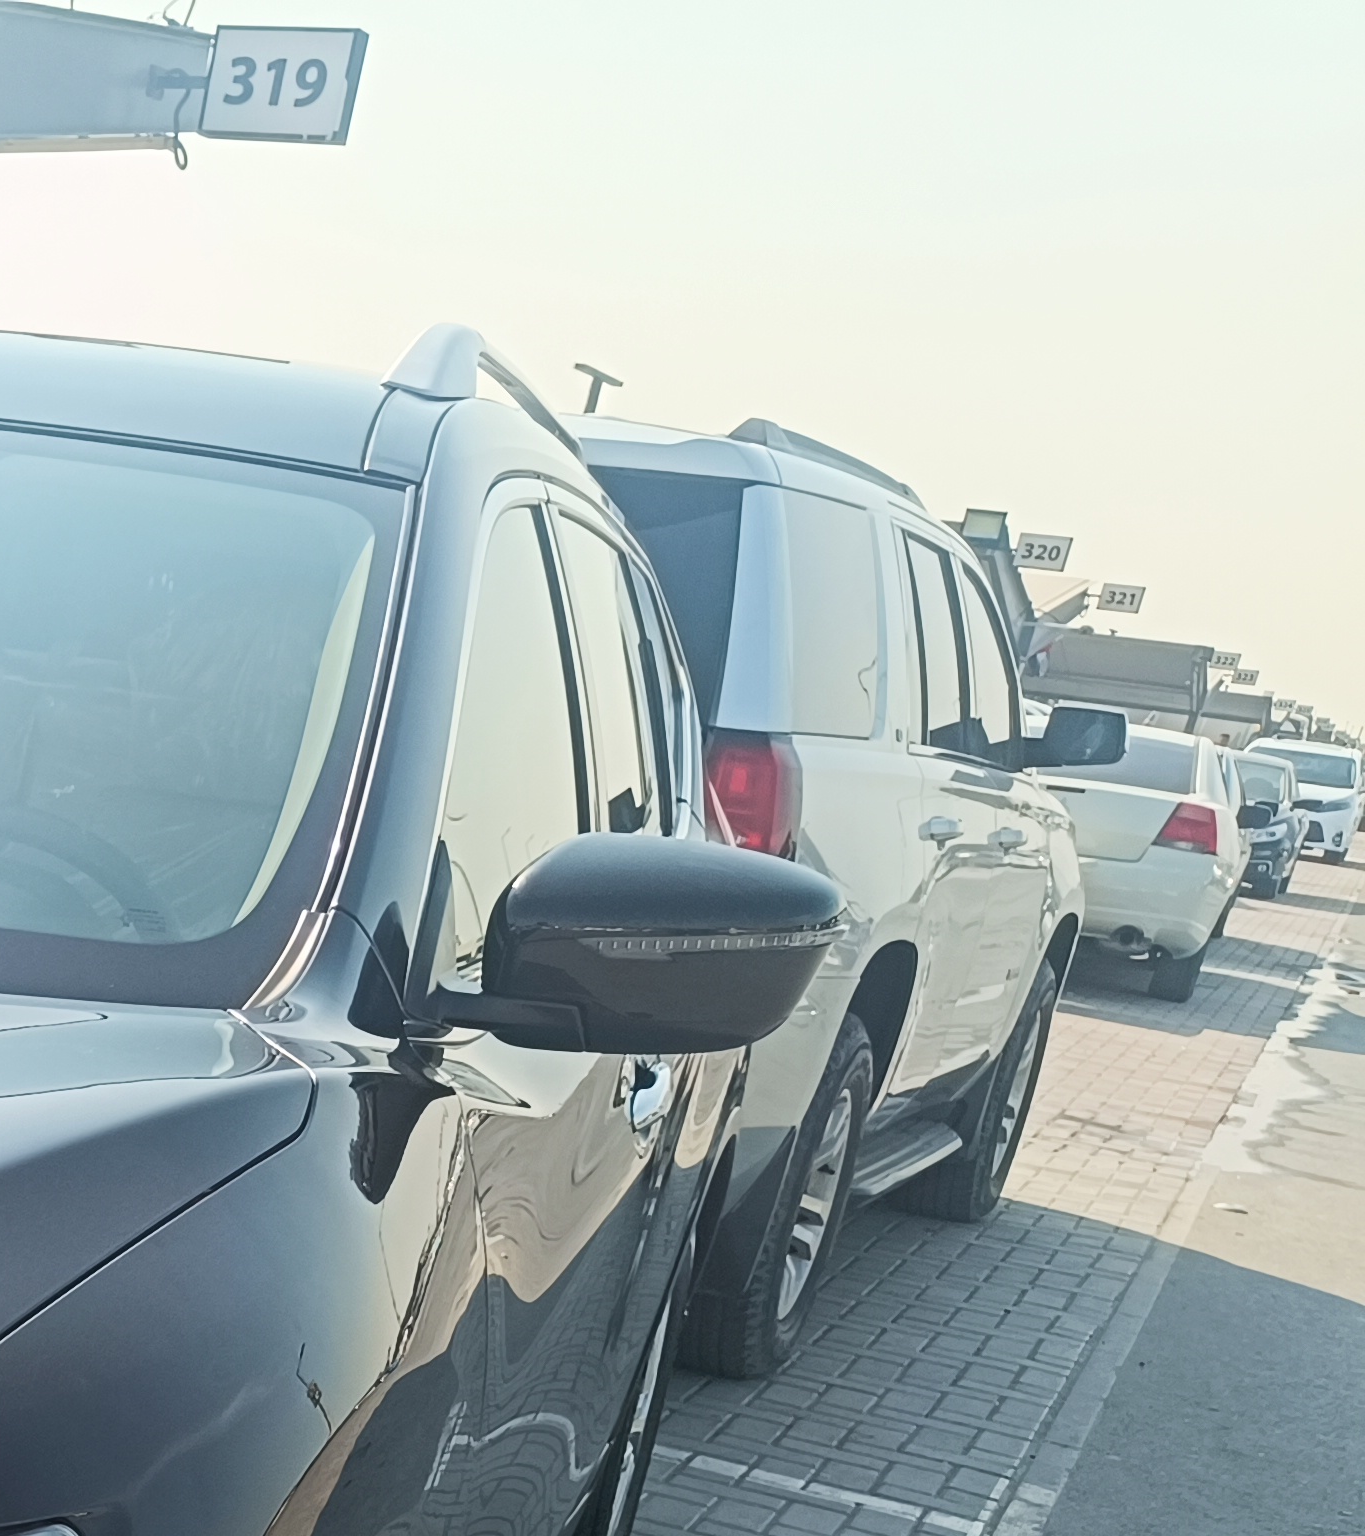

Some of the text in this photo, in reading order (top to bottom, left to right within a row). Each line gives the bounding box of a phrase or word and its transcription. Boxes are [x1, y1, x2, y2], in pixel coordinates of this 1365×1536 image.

[222, 56, 328, 108] 319
[1021, 543, 1061, 562] 320
[1105, 591, 1137, 606] 321
[1214, 655, 1237, 666] 322
[1236, 672, 1254, 682] 323
